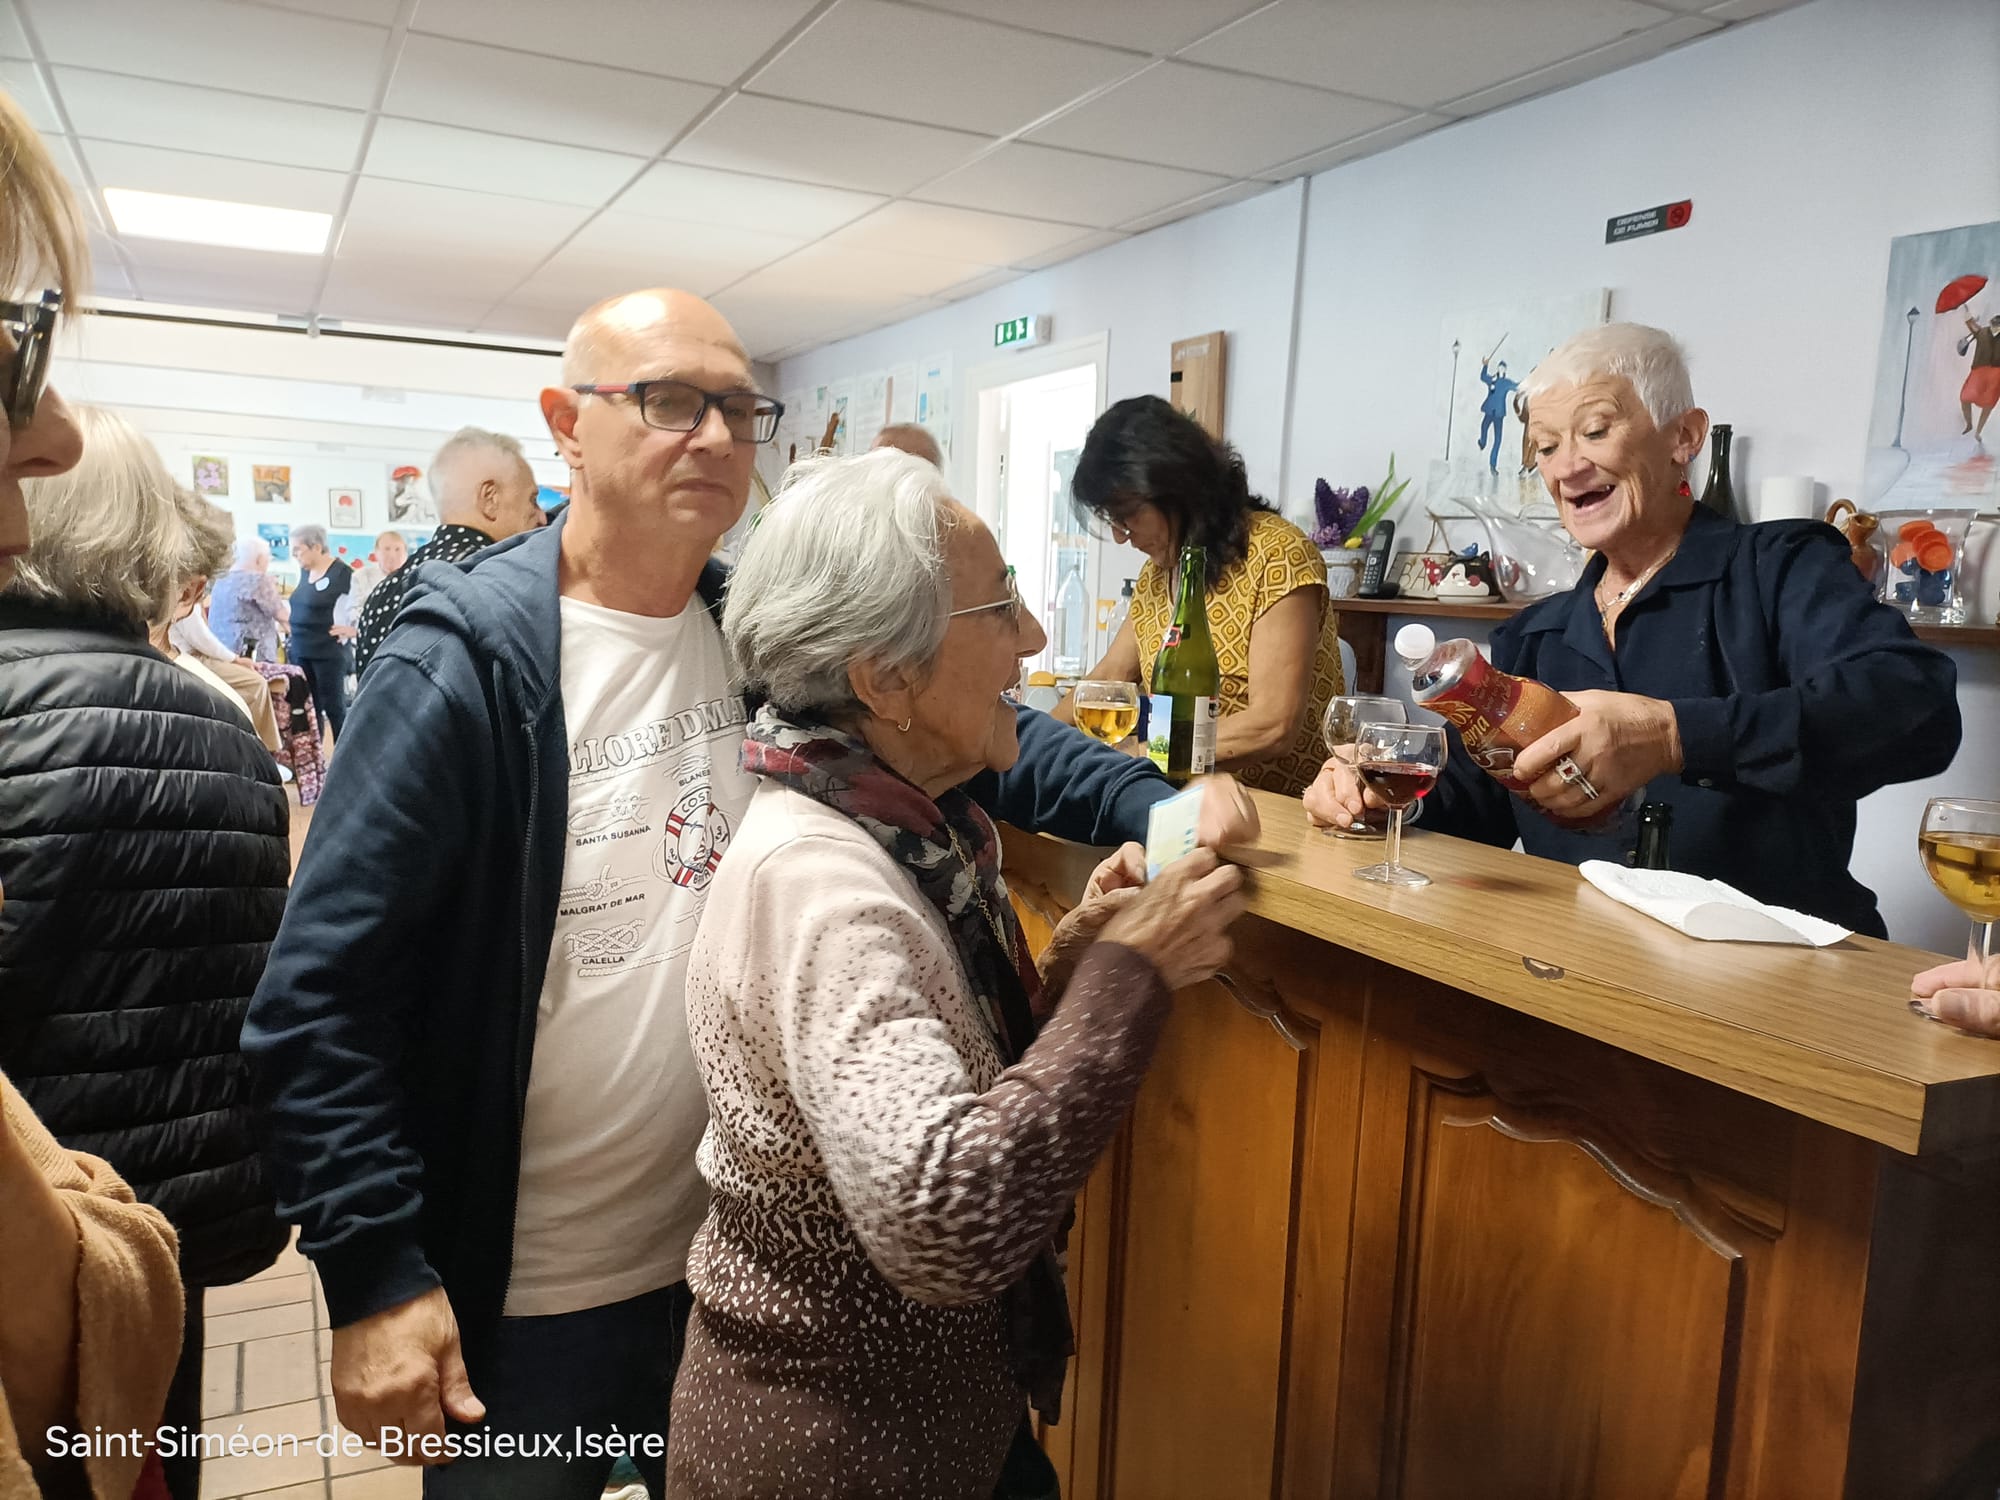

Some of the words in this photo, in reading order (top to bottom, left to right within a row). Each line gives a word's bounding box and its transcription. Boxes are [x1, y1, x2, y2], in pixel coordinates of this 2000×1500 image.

[1399, 562, 1433, 591] BA
[575, 834, 608, 847] SANTA
[610, 825, 652, 840] SUSANNA
[560, 902, 608, 916] MALGRAT
[610, 899, 623, 908] DE
[625, 893, 645, 904] MAR
[581, 956, 625, 965] CALELLA
